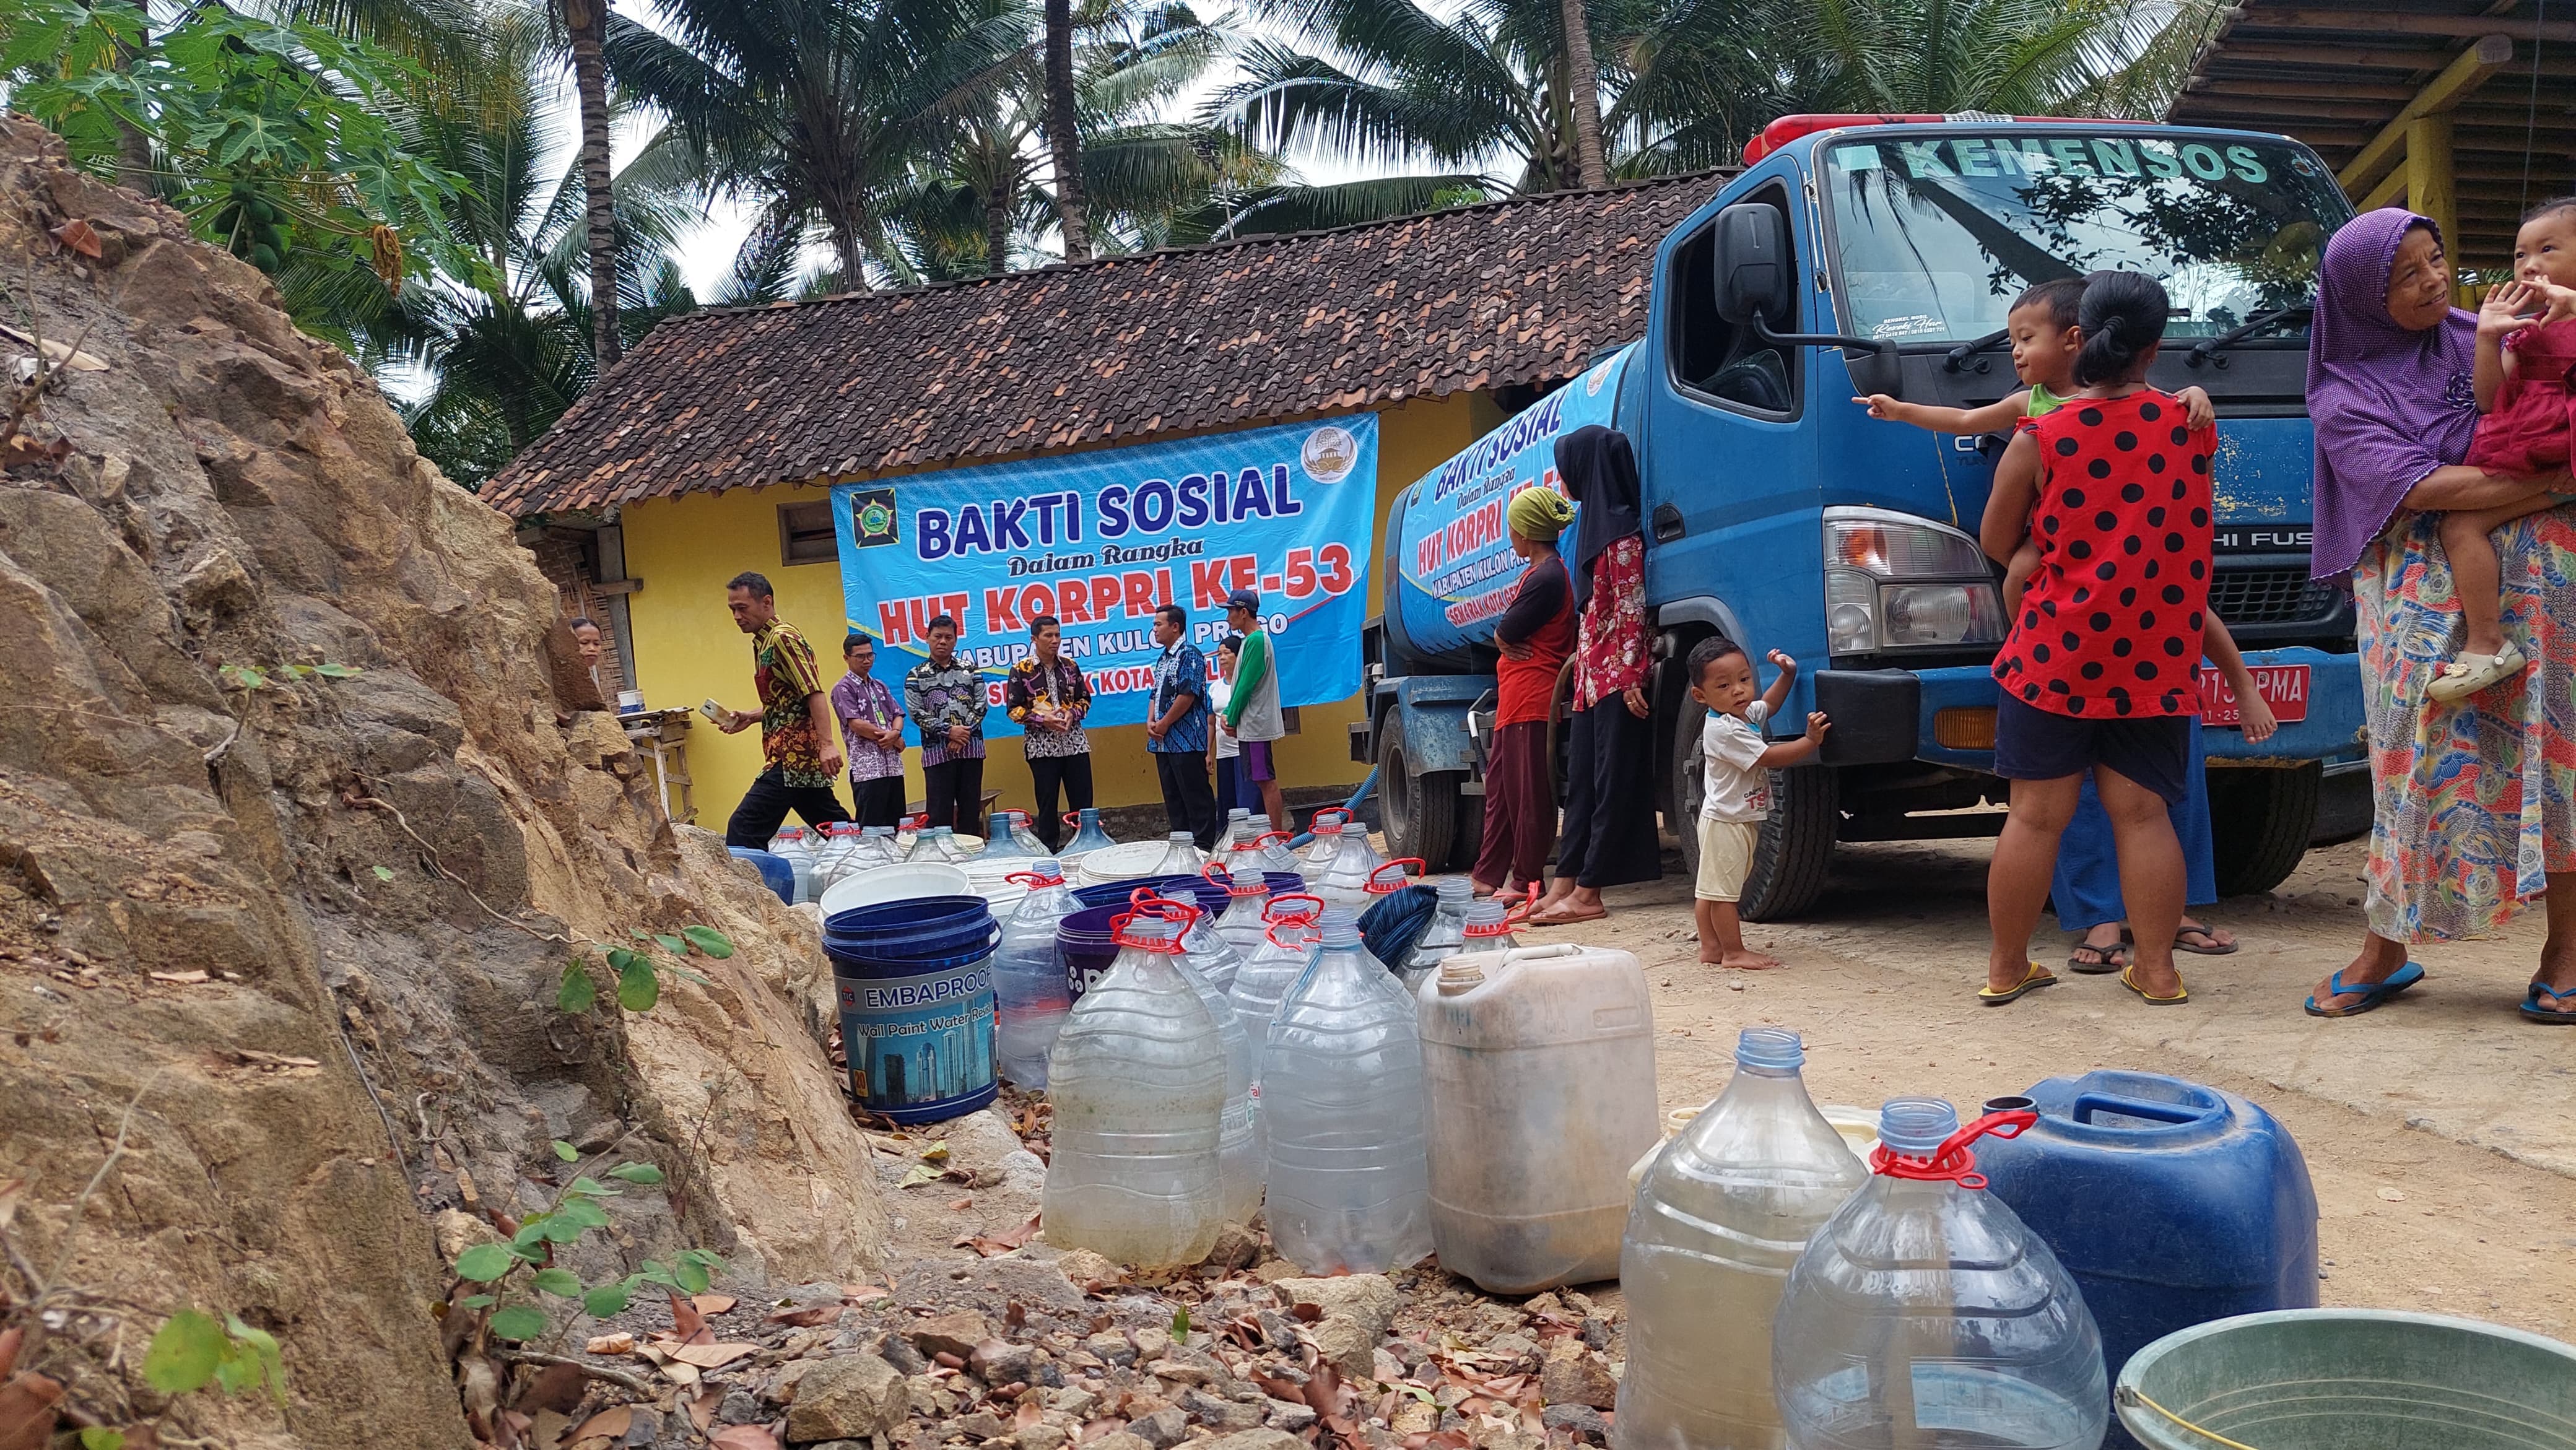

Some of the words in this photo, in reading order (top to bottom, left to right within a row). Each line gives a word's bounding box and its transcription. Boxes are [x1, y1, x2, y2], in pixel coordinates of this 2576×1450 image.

[1899, 139, 2267, 183] KEMENSOS
[1435, 435, 1492, 501] BAKTI
[1487, 387, 1569, 469] SOSIAL
[918, 492, 1081, 559] BAKTI
[1099, 465, 1302, 536] SOSIAL
[1456, 487, 1481, 511] Dalam
[1007, 553, 1095, 576] Dalam
[1101, 537, 1204, 565] Rangka
[1418, 531, 1443, 576] HUT
[1447, 498, 1502, 562] KORPRI
[2251, 532, 2313, 545] FUS
[879, 593, 968, 646] HUT
[985, 569, 1173, 633] KORPRI
[1190, 544, 1353, 609] KE-53
[1432, 563, 1478, 599] KABUPATEN
[1477, 549, 1510, 581] KULON
[1100, 667, 1155, 693] KOTA
[2256, 670, 2302, 702] PMA
[866, 965, 991, 1007] EMBAPROOF
[858, 1024, 885, 1037] Wall
[889, 1022, 926, 1036] Paint
[930, 1014, 970, 1031] Water
